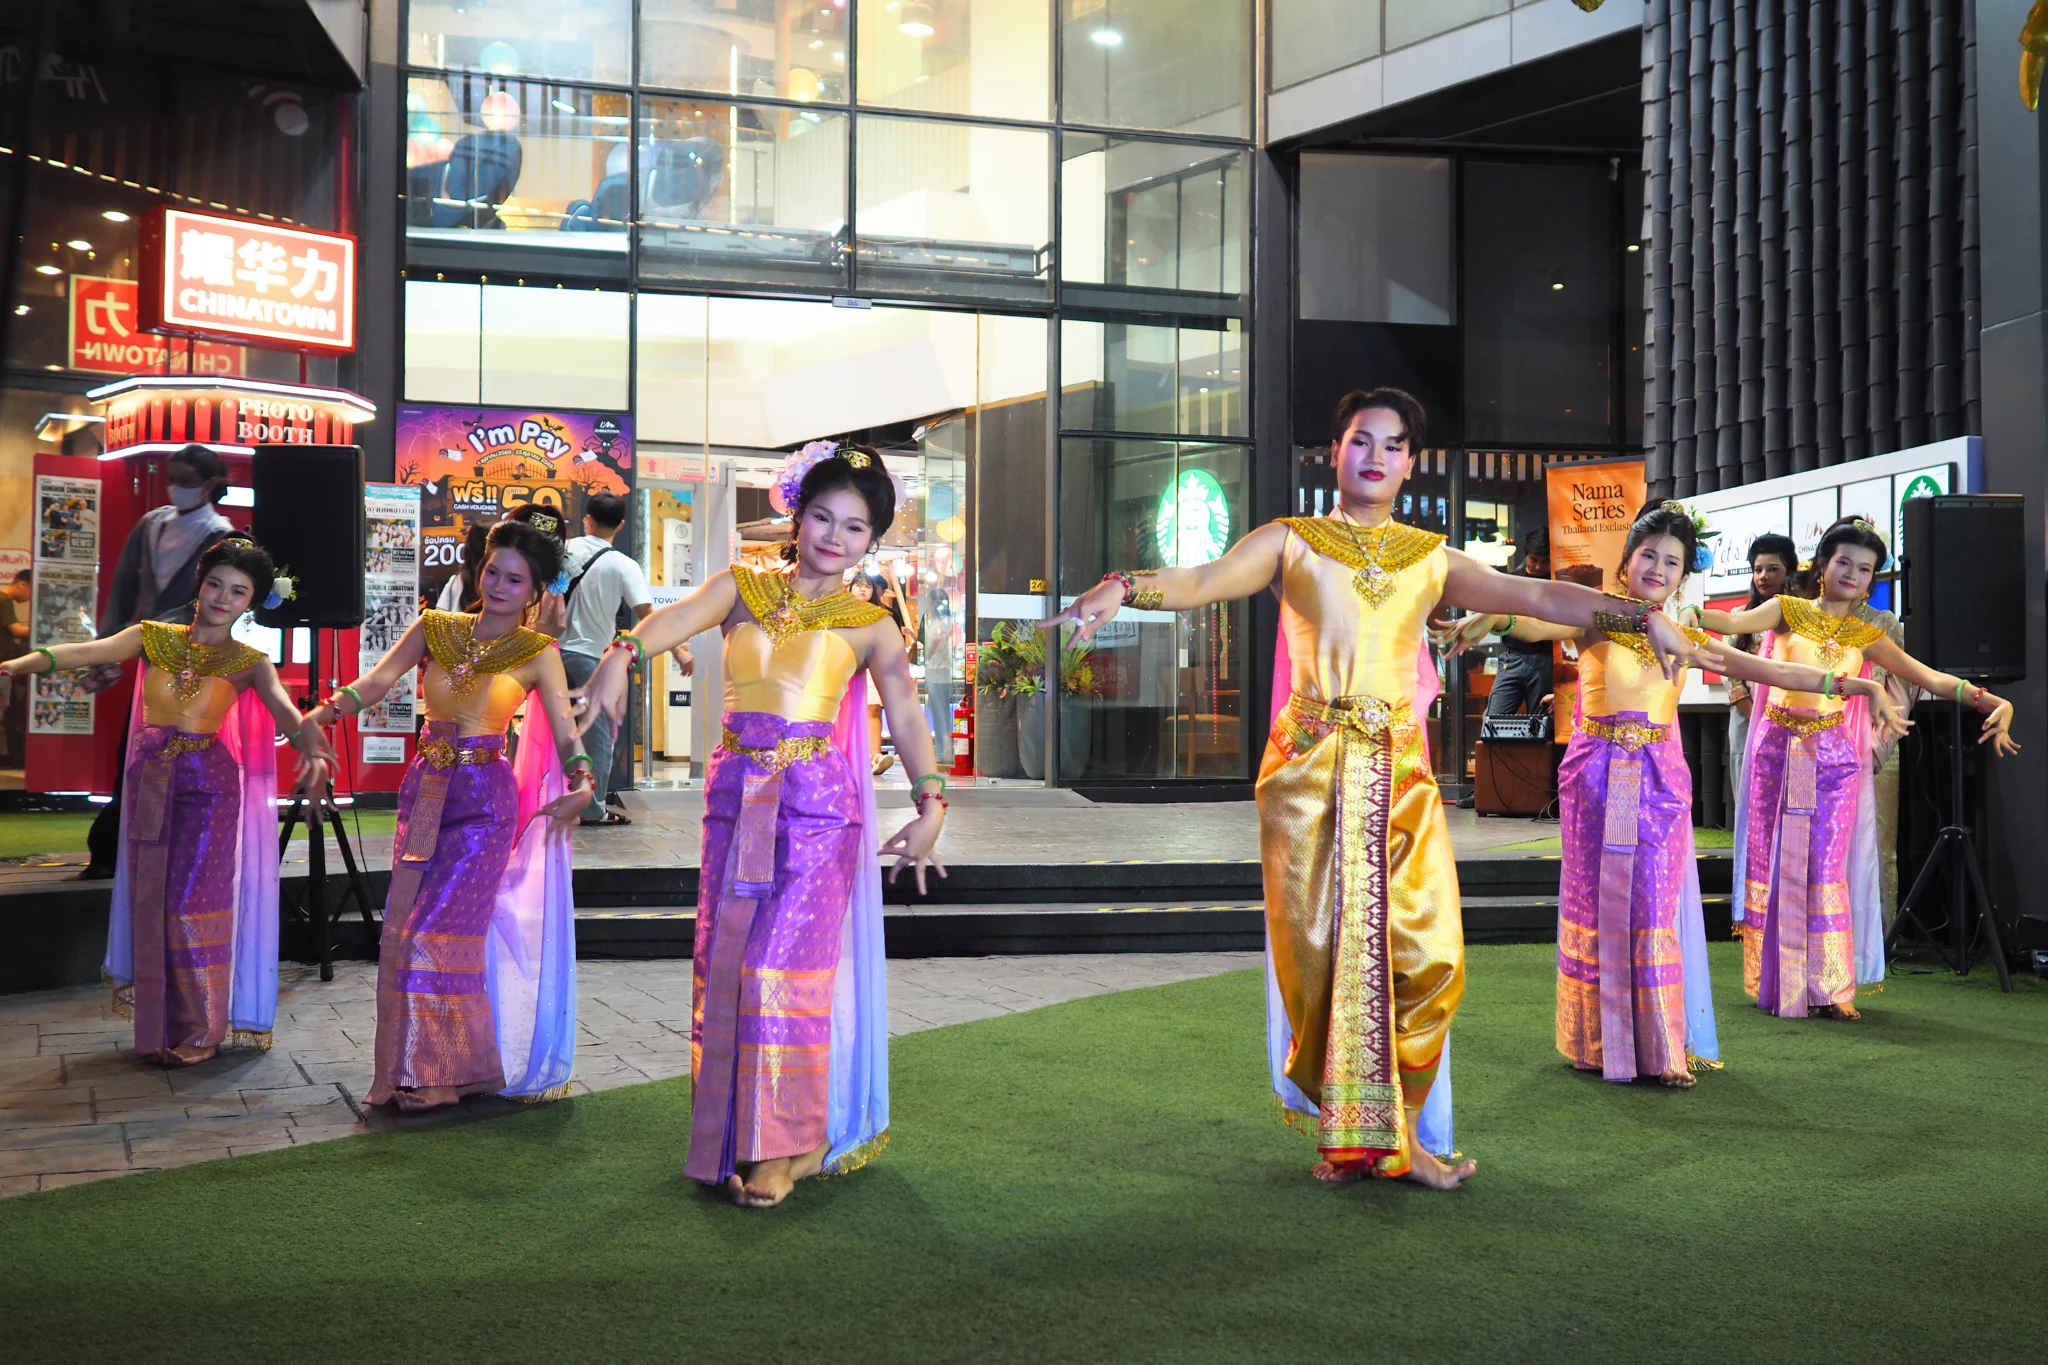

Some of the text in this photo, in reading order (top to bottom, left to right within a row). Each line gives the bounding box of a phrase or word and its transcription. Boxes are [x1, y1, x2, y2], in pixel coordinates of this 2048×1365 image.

[179, 288, 336, 332] CHINATOWN
[238, 398, 314, 421] PHOTO
[238, 421, 314, 444] BOOTH
[468, 421, 569, 459] I'm Pay
[1572, 483, 1624, 501] Nama
[1573, 501, 1625, 521] Series
[1561, 521, 1632, 534] Thailand Exclusiv
[1798, 543, 1818, 553] CHINAT
[1031, 581, 1042, 589] 24
